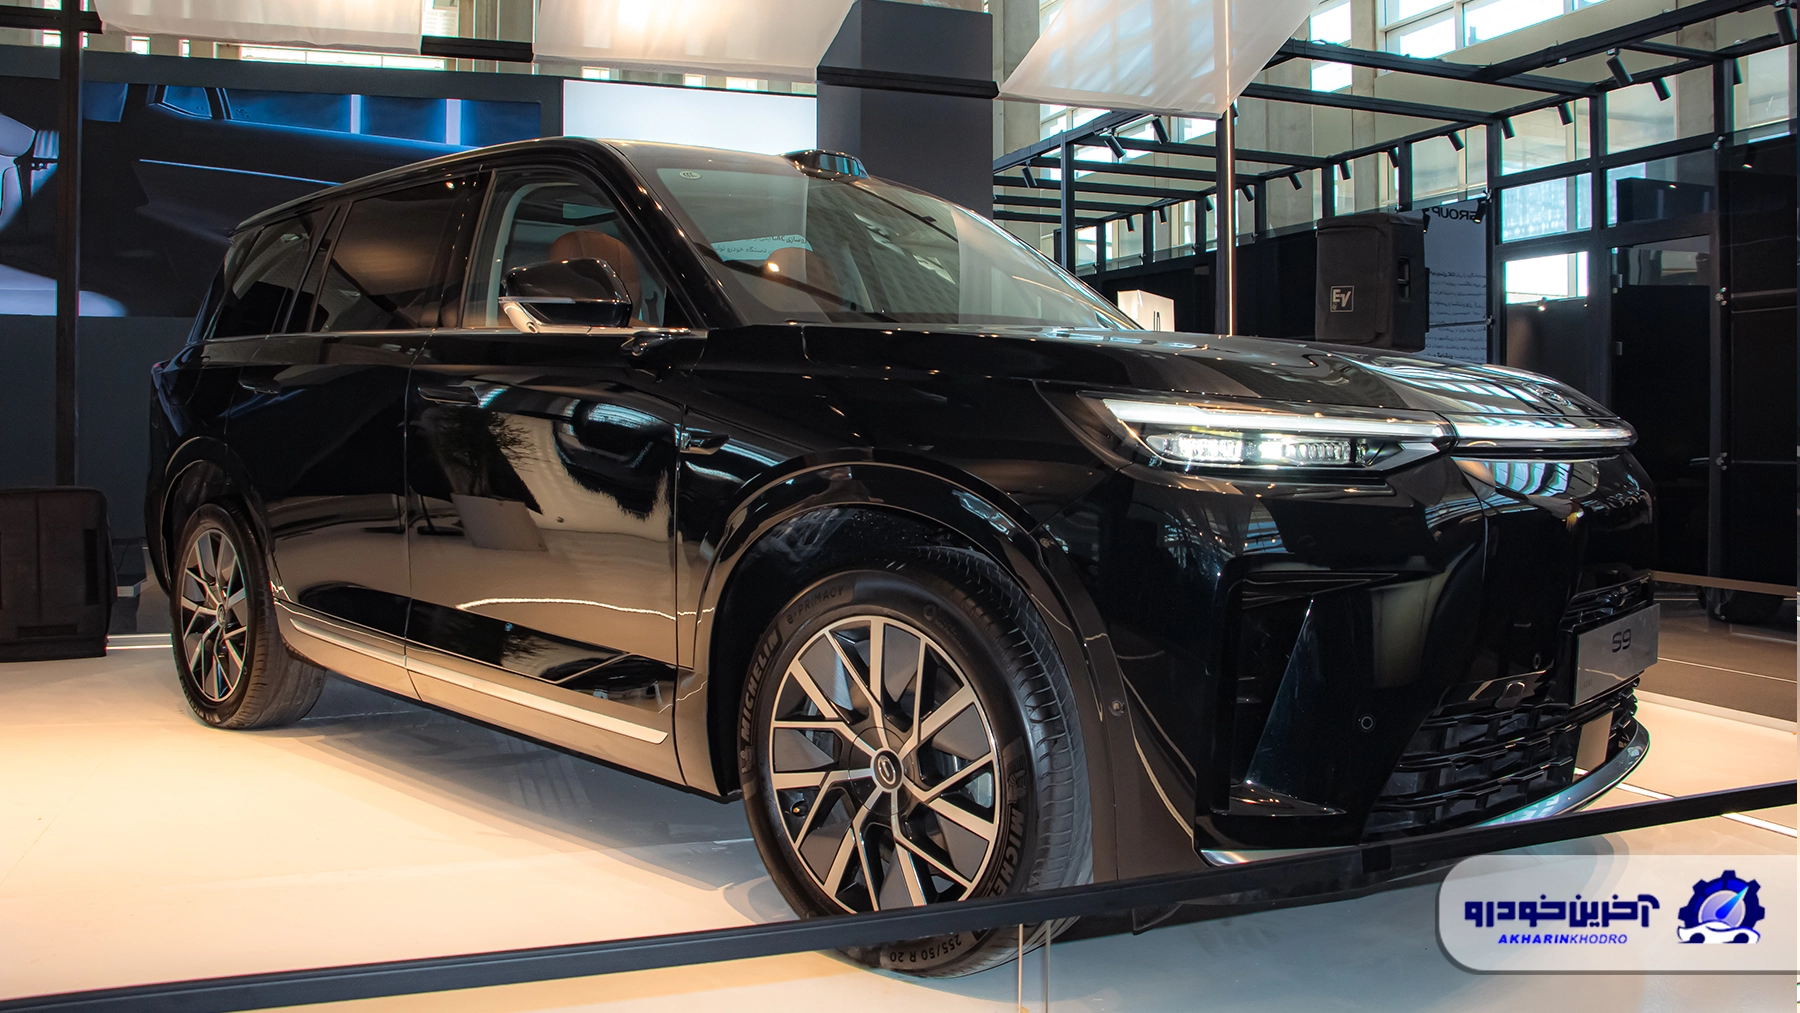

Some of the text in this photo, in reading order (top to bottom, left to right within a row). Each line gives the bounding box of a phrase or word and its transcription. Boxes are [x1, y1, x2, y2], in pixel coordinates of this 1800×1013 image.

[1332, 288, 1352, 307] EV
[1611, 628, 1632, 653] S9
[740, 630, 781, 743] MICHELIN
[889, 934, 962, 962] 255/50 R 20
